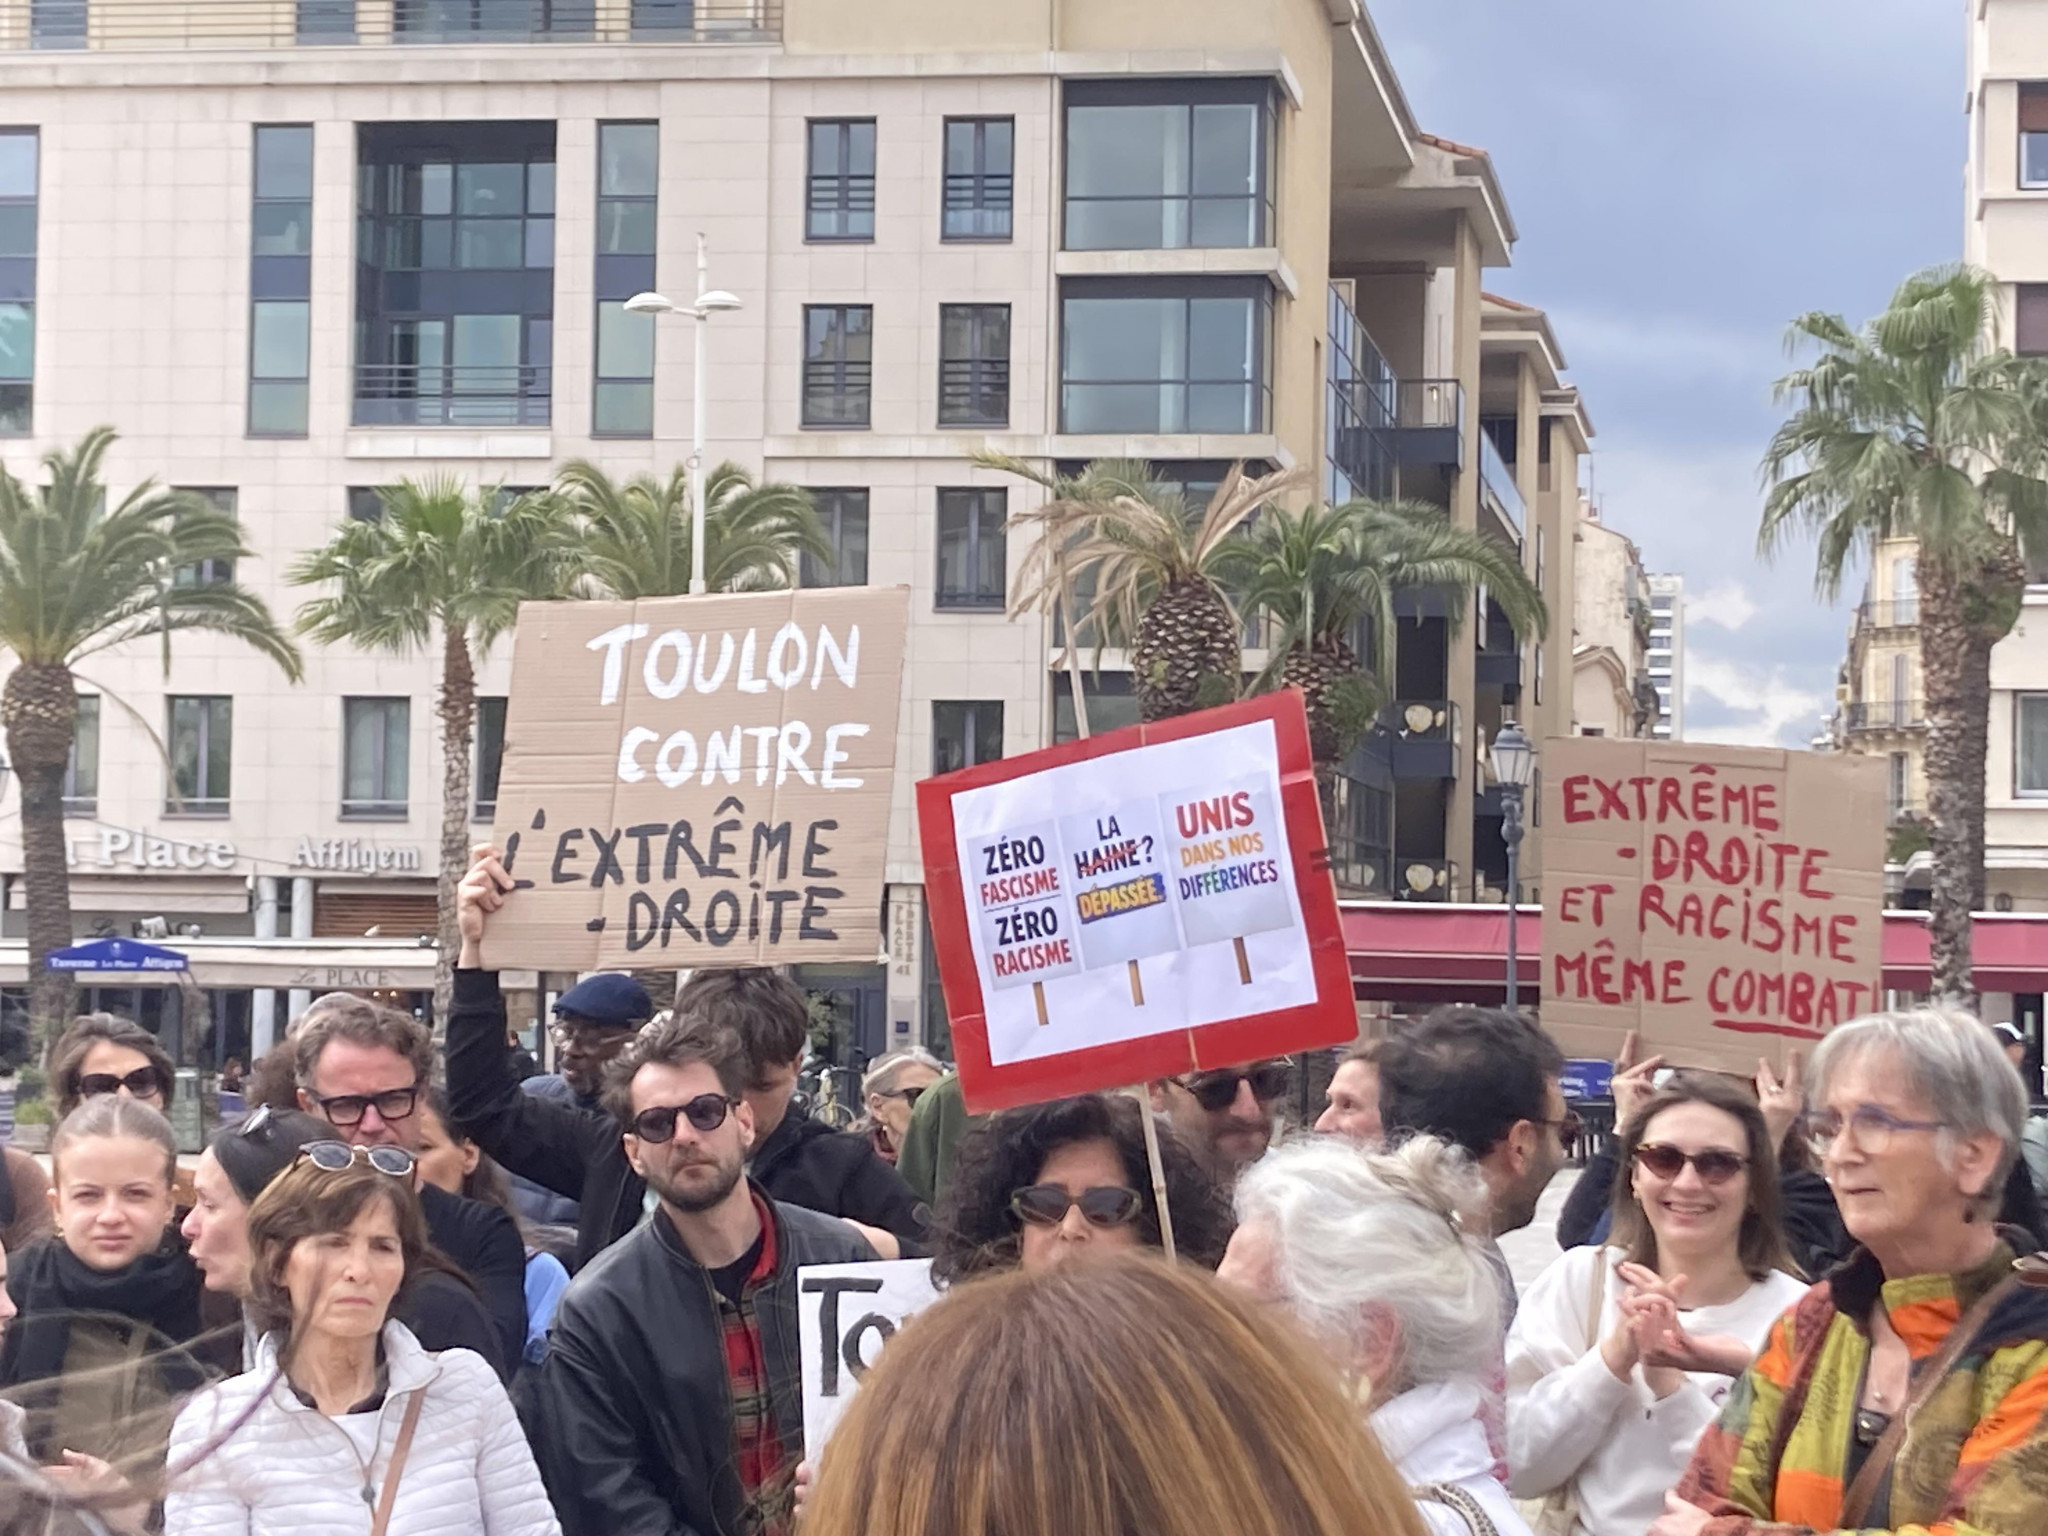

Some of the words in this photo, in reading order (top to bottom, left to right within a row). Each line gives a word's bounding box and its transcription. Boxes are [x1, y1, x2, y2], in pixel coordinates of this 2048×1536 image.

[586, 622, 859, 705] TOULON
[617, 720, 869, 788] CONTRE
[1175, 791, 1254, 839] UNIS
[1562, 763, 1779, 831] EXTRÊME
[97, 827, 236, 869] Place
[504, 797, 838, 887] L'EXTRÊME
[1097, 815, 1121, 841] LA
[293, 835, 420, 874] Affligem
[983, 835, 1045, 876] ZÉRO
[1180, 839, 1225, 868] DANS
[1229, 832, 1264, 858] NOS
[981, 867, 1059, 906] FASCISME
[1179, 858, 1278, 901] DIFFÉRENCES
[1560, 882, 1614, 926] ET
[995, 906, 1058, 946] ZÉRO
[326, 969, 390, 986] PLACE
[896, 965, 911, 976] 41
[993, 938, 1072, 977] RACISME
[1555, 937, 1692, 1004] MÊME
